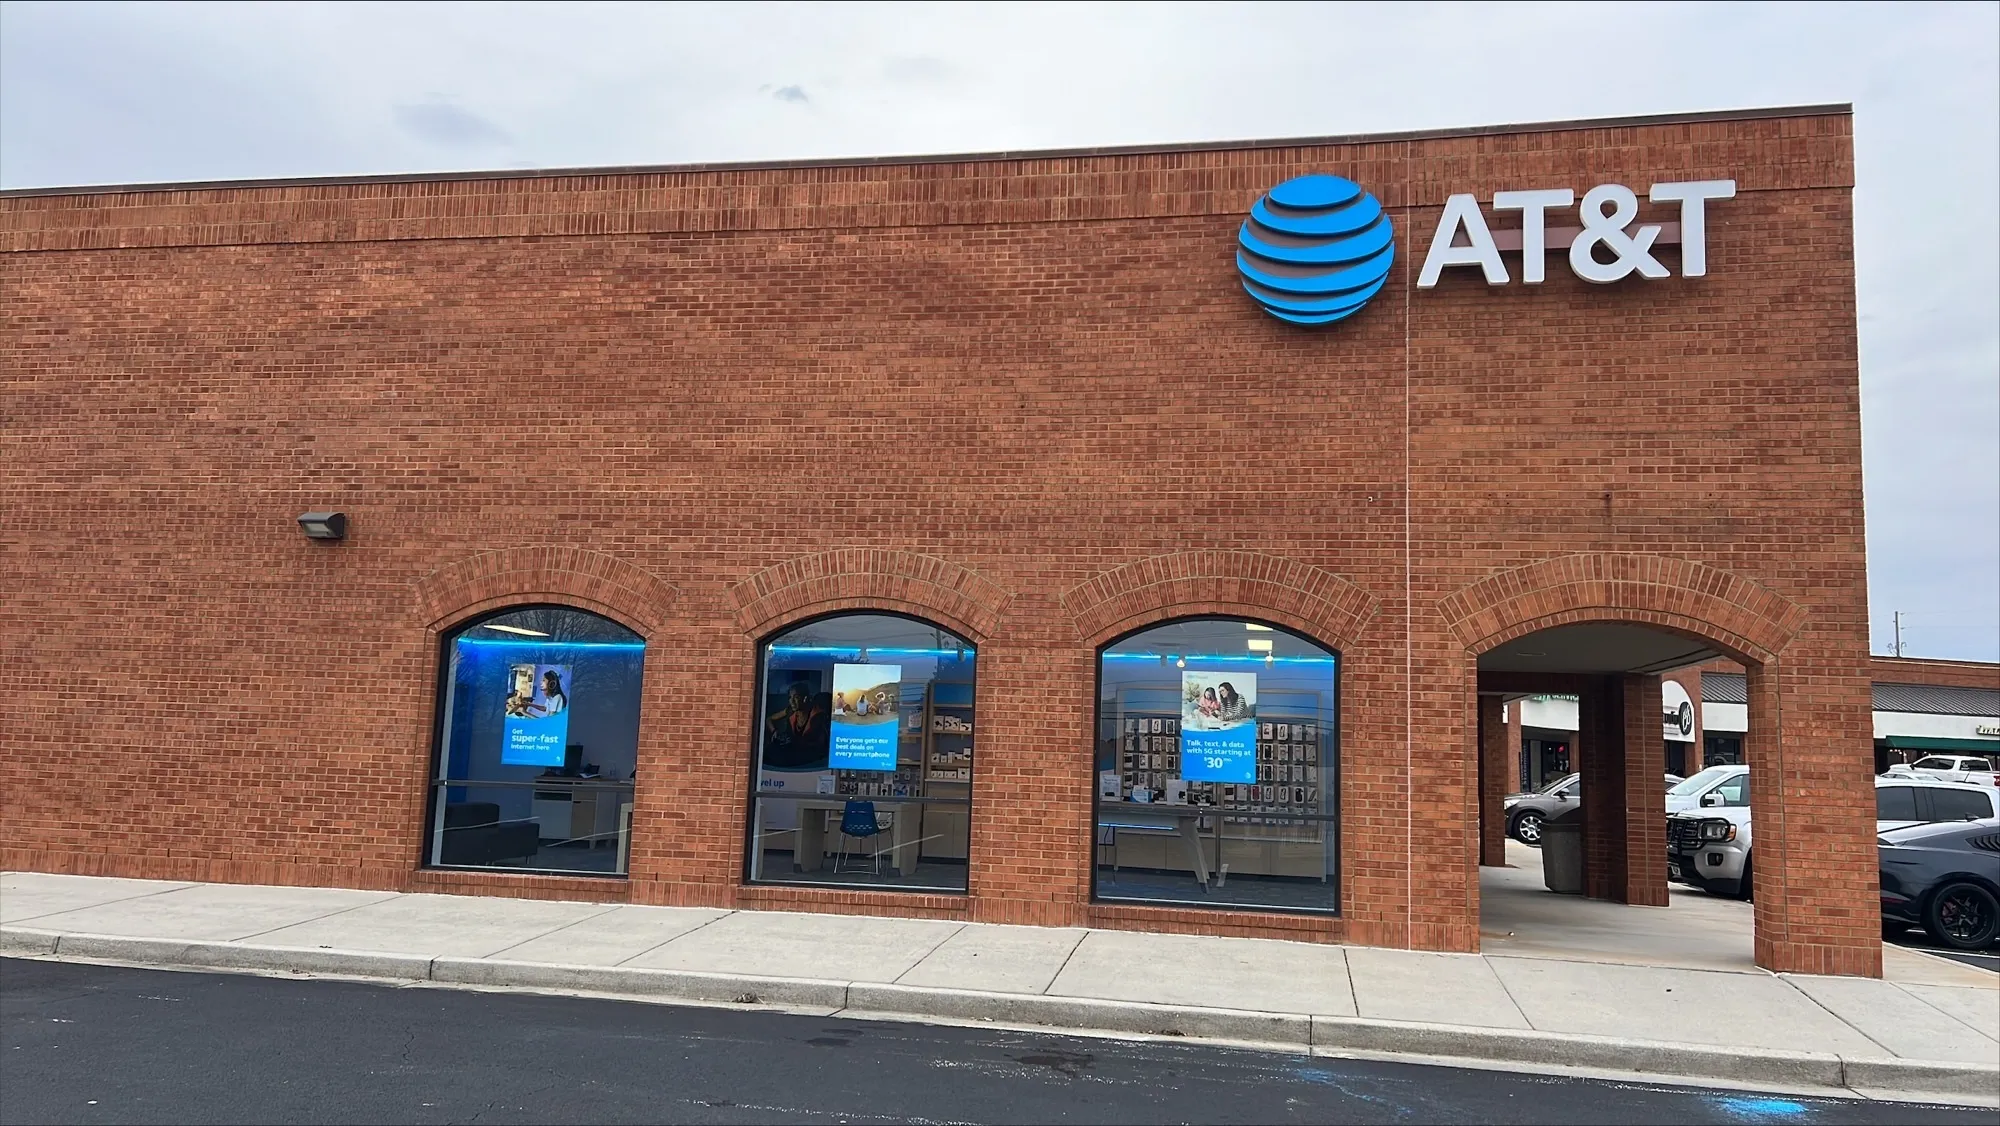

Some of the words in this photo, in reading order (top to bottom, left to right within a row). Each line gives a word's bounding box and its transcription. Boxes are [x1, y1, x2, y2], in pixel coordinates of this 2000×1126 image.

[1416, 179, 1736, 289] AT&T
[512, 734, 558, 744] super-fast
[1214, 748, 1242, 757] starting
[774, 780, 784, 789] up
